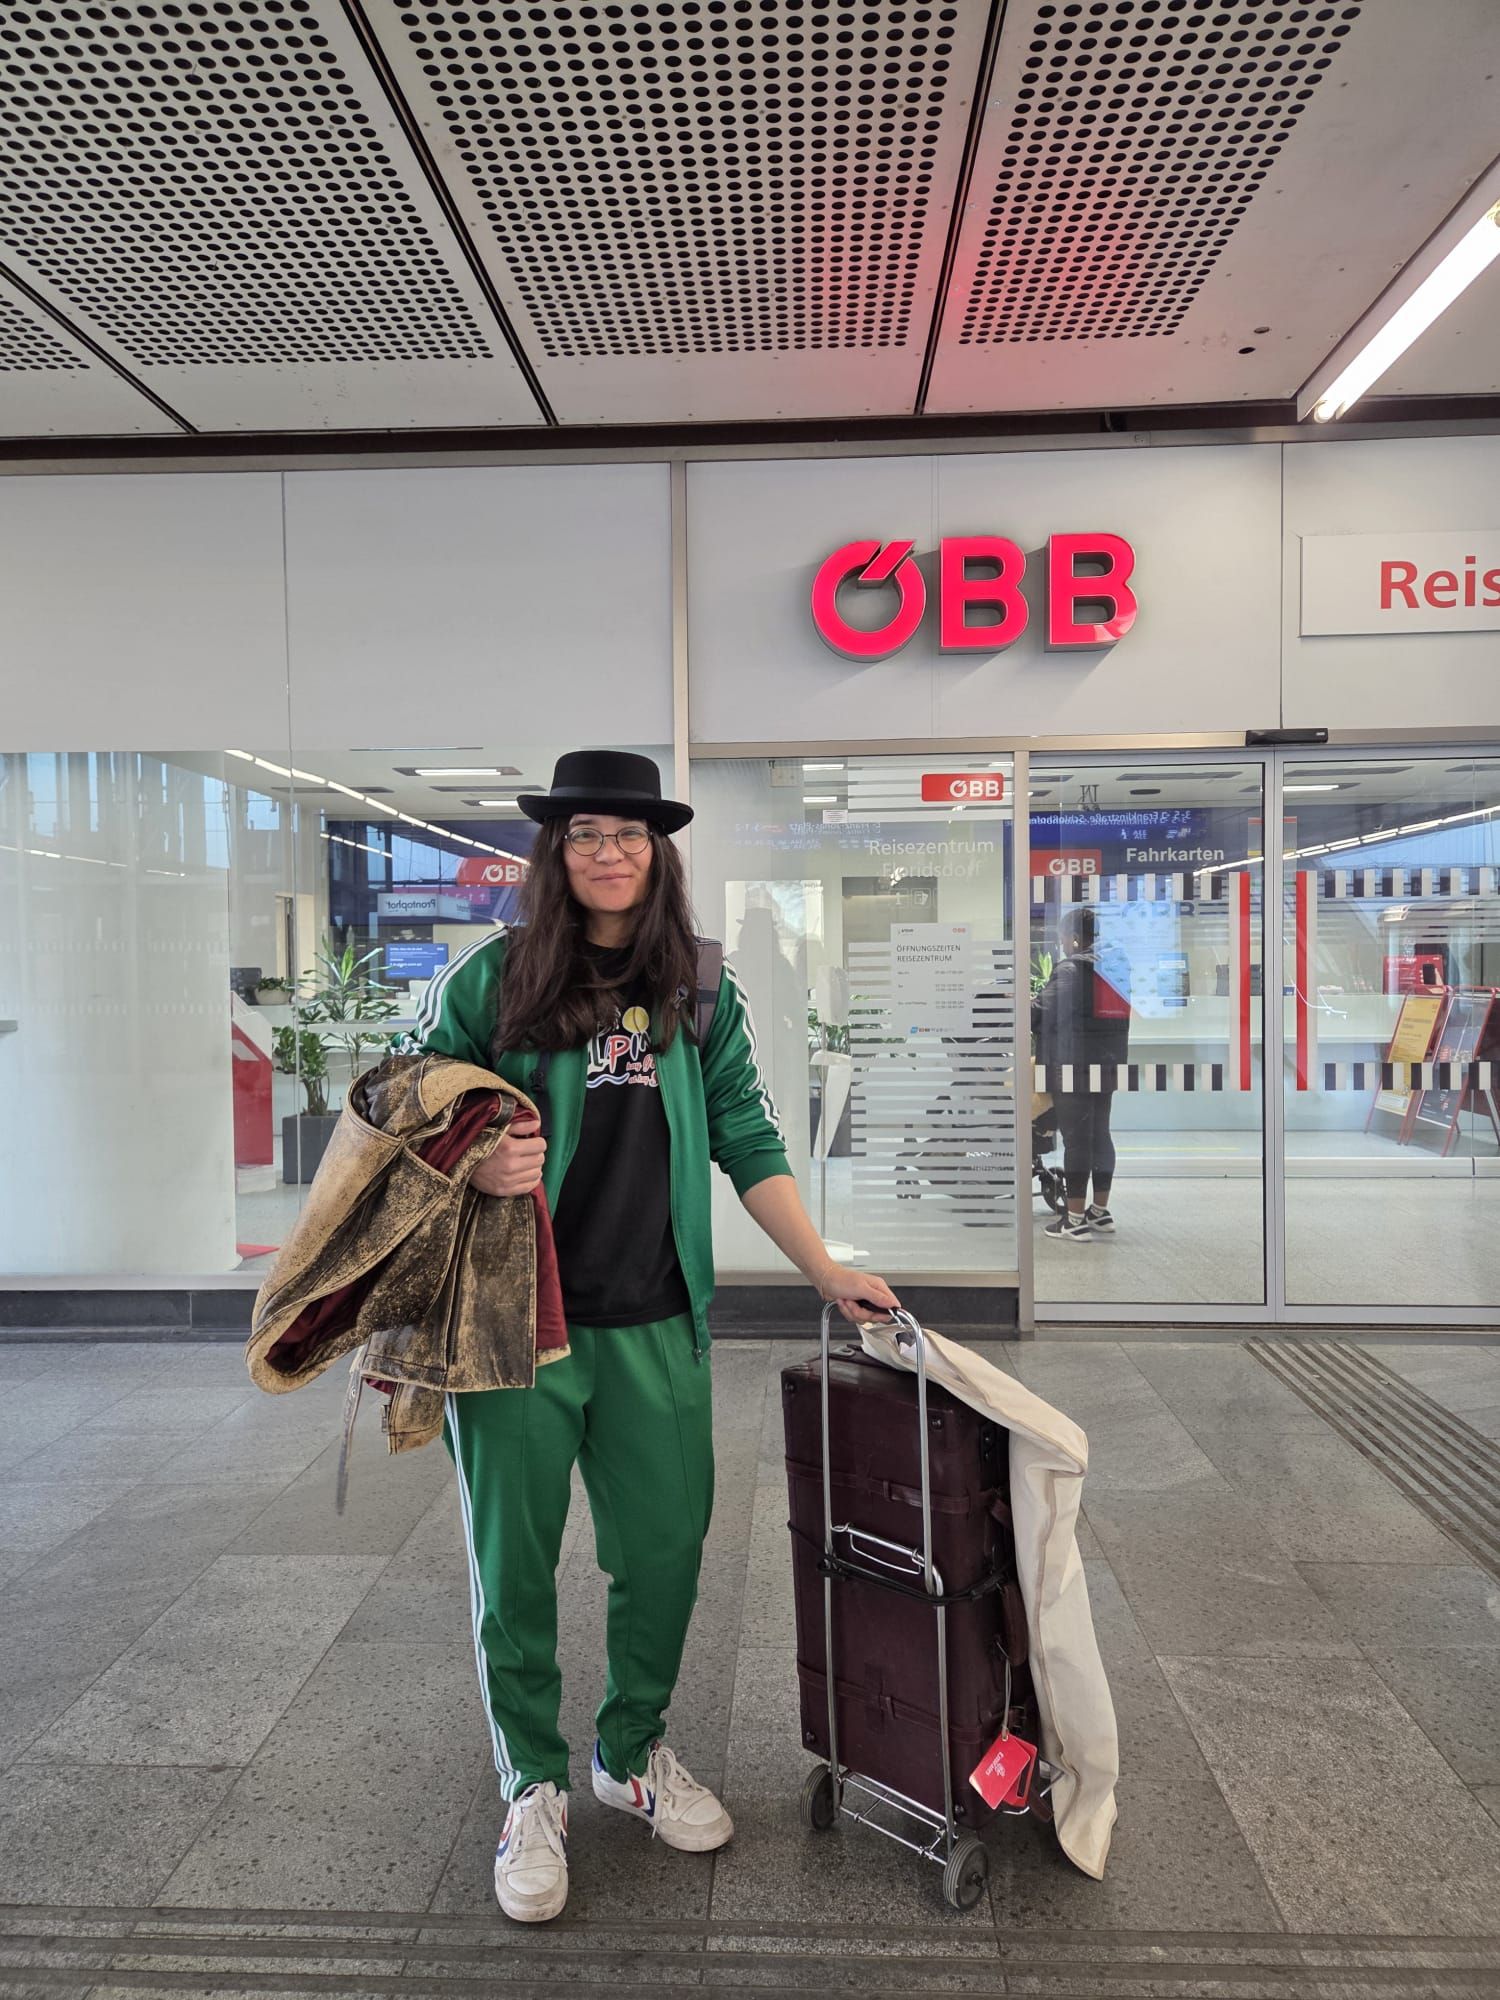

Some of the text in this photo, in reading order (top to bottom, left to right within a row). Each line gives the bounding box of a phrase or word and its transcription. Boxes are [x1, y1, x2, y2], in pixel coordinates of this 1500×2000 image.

[1380, 555, 1500, 609] Reis
[811, 532, 1138, 660] ÖBB
[949, 779, 1000, 798] ÖBB
[869, 838, 994, 856] Reisezentrum
[1126, 846, 1225, 863] Fahrkarten
[1049, 858, 1096, 875] ÖBB
[896, 944, 961, 953] ÖFFNUNGSZEITEN
[896, 954, 952, 963] REISEZENTRUM
